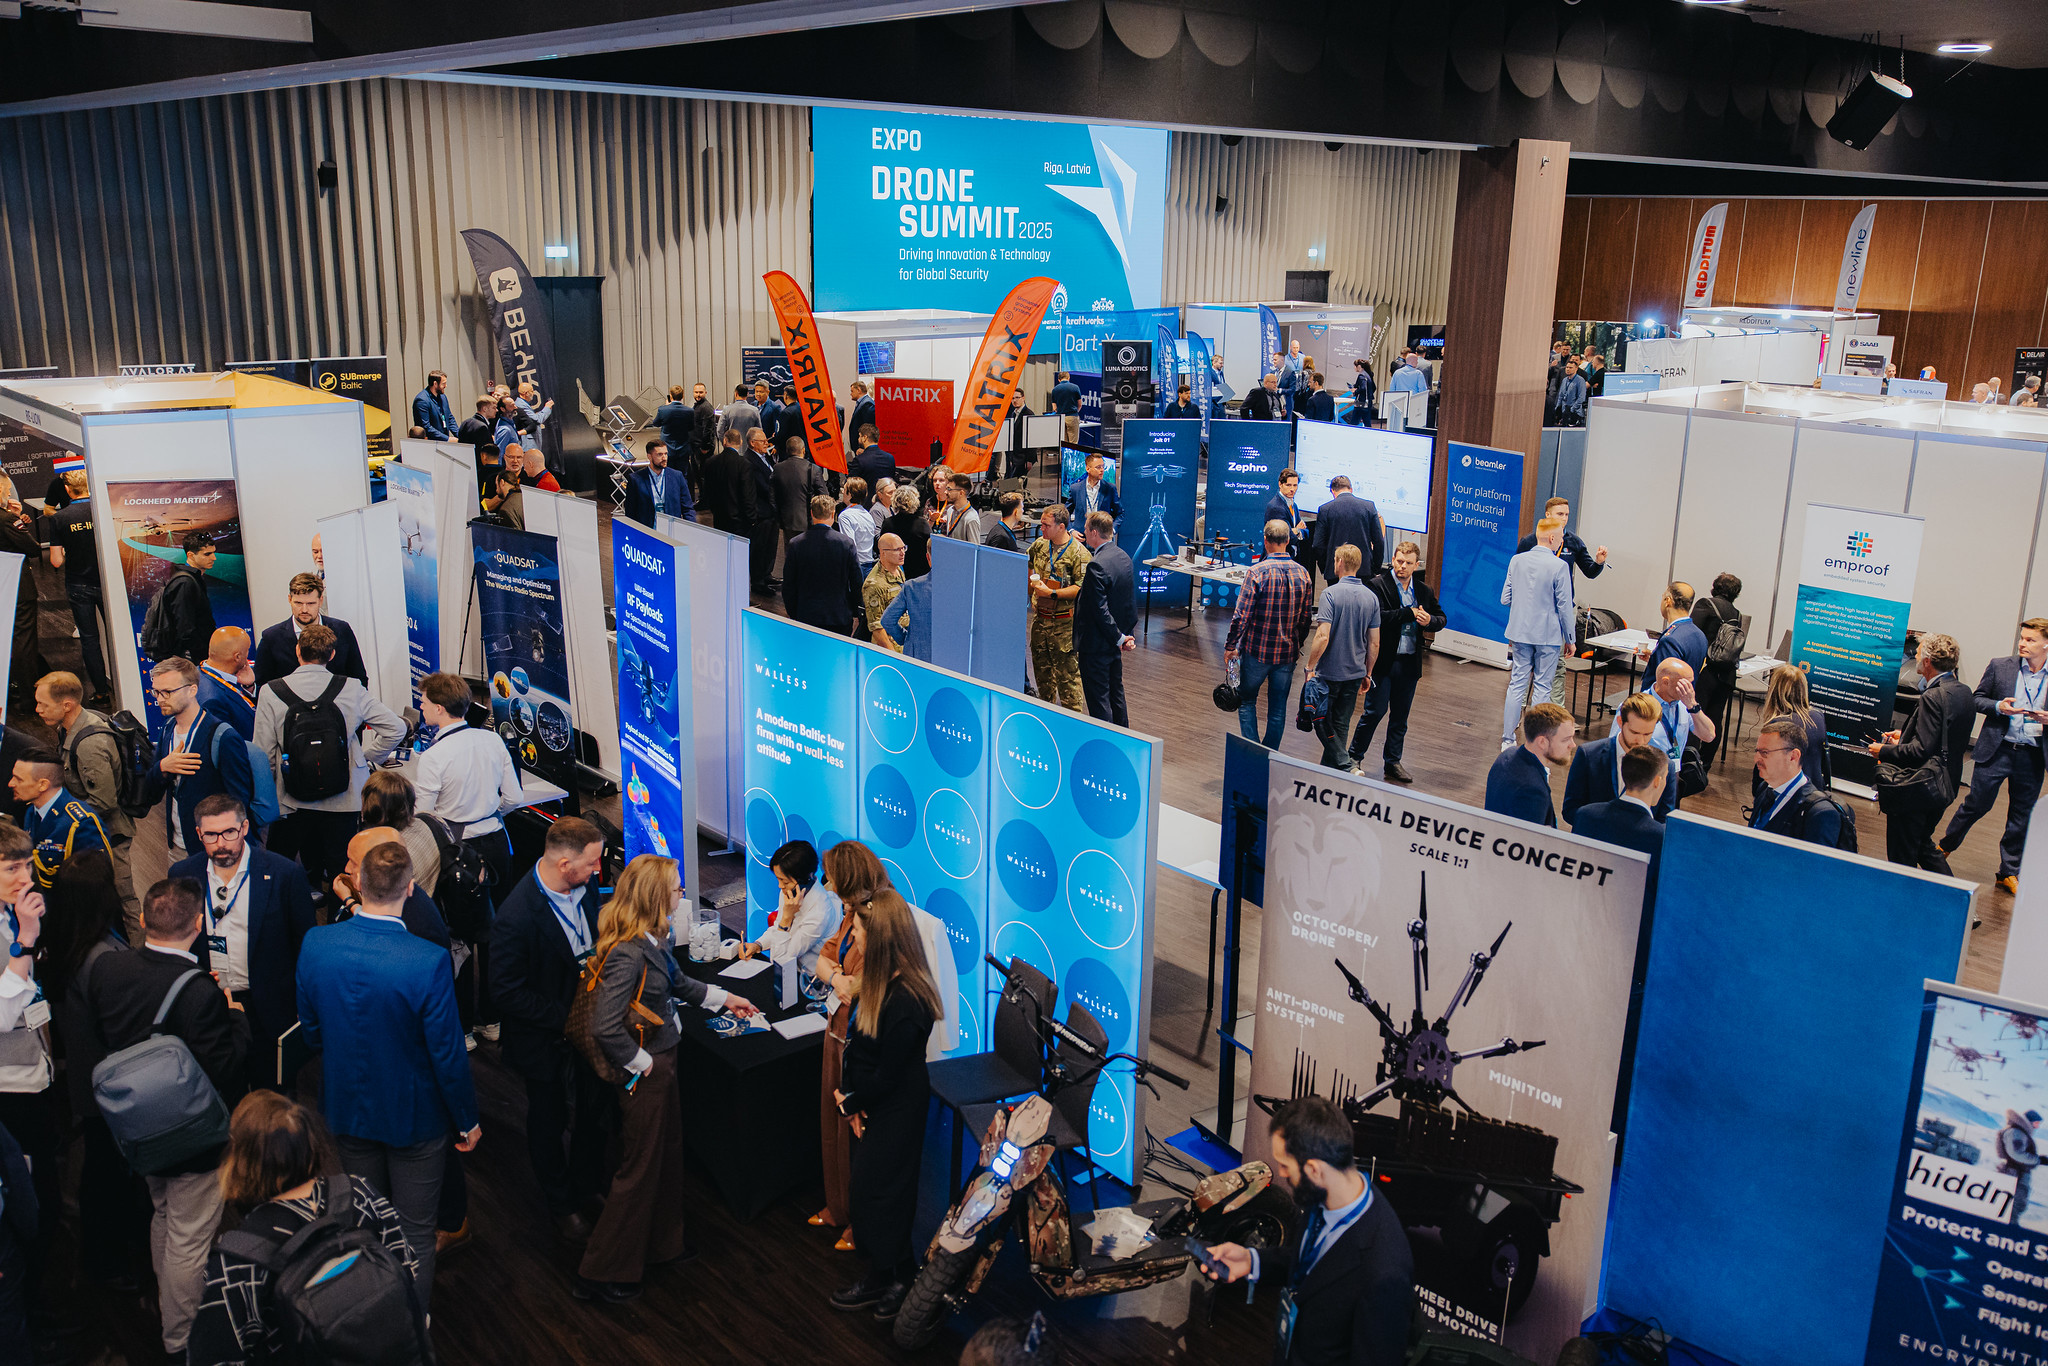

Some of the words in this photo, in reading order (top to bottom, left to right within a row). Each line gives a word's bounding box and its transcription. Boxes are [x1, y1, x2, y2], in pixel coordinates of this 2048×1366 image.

[872, 128, 921, 151] EXPO
[1044, 162, 1064, 175] Riga,
[1066, 163, 1091, 174] Latvia
[872, 166, 974, 202] DRONE
[900, 205, 1019, 238] SUMMIT
[1019, 222, 1052, 239] 2025
[900, 248, 933, 262] Driving
[936, 249, 987, 261] Innovation
[991, 249, 996, 260] &
[1000, 249, 1051, 262] Technology
[1695, 226, 1716, 297] REDDITUM
[1846, 229, 1866, 296] newline
[899, 269, 912, 280] for
[917, 269, 946, 280] Global
[950, 269, 989, 282] Security
[1066, 316, 1104, 325] krattworks
[340, 373, 381, 381] SUBmerge
[964, 324, 1029, 450] NATRIX
[880, 387, 940, 403] NATRIX
[1228, 462, 1268, 473] Zephro
[1475, 457, 1506, 470] beamler
[1453, 483, 1473, 495] Your
[1475, 487, 1511, 502] platform
[1452, 497, 1463, 508] for
[1466, 500, 1505, 516] industrial
[1451, 512, 1462, 522] 3D
[1465, 516, 1497, 533] printing
[497, 553, 535, 569] QUADSAT
[625, 544, 662, 576] QUADSAT
[1825, 558, 1890, 576] emproof
[487, 571, 511, 583] Managing
[523, 579, 551, 591] Optimizing
[496, 582, 513, 592] World's
[515, 586, 528, 595] Radio
[529, 590, 554, 601] Spectrum
[627, 592, 635, 607] RF
[636, 597, 663, 623] Payloads
[1847, 614, 1874, 623] embedded
[1803, 646, 1831, 656] embedded
[1832, 652, 1848, 660] system
[1850, 650, 1875, 659] approach
[755, 663, 807, 690] WALLESS
[874, 700, 907, 718] WALLESS
[756, 708, 763, 719] A
[765, 712, 798, 733] modern
[800, 724, 826, 745] Baltic
[828, 734, 844, 751] law
[935, 723, 972, 742] WALLESS
[756, 724, 774, 741] firm
[776, 734, 794, 750] with
[796, 744, 802, 752] a
[804, 745, 844, 768] wall-less
[757, 744, 791, 765] attitude
[1009, 750, 1048, 772] WALLESS
[1083, 778, 1127, 800] WALLESS
[874, 797, 907, 817] WALLESS
[935, 823, 970, 845] WALLESS
[1293, 780, 1393, 824] TACTICAL
[1400, 811, 1485, 851] DEVICE
[1492, 838, 1614, 887] CONCEPT
[1007, 854, 1046, 878] WALLESS
[1410, 842, 1449, 864] SCALE
[1453, 855, 1469, 869] 1:1
[1080, 887, 1122, 912] WALLESS
[946, 926, 970, 943] LLESS
[1291, 926, 1336, 948] DRONE
[1292, 911, 1379, 948] OCTOCOPER/
[1077, 992, 1119, 1020] WALLESS
[1265, 1001, 1316, 1028] SYSTEM
[1266, 987, 1345, 1025] ANTI-DRONE
[1489, 1069, 1562, 1109] MUNITION
[1907, 1154, 2015, 1219] hiddn
[1902, 1205, 1982, 1242] Protect
[1985, 1233, 2030, 1256] and
[1986, 1260, 2048, 1290] Operat
[1982, 1284, 2047, 1313] Sensor
[1456, 1306, 1498, 1336] DRIVE
[1978, 1307, 2031, 1334] Flight
[1899, 1334, 2003, 1366] ENCRYP
